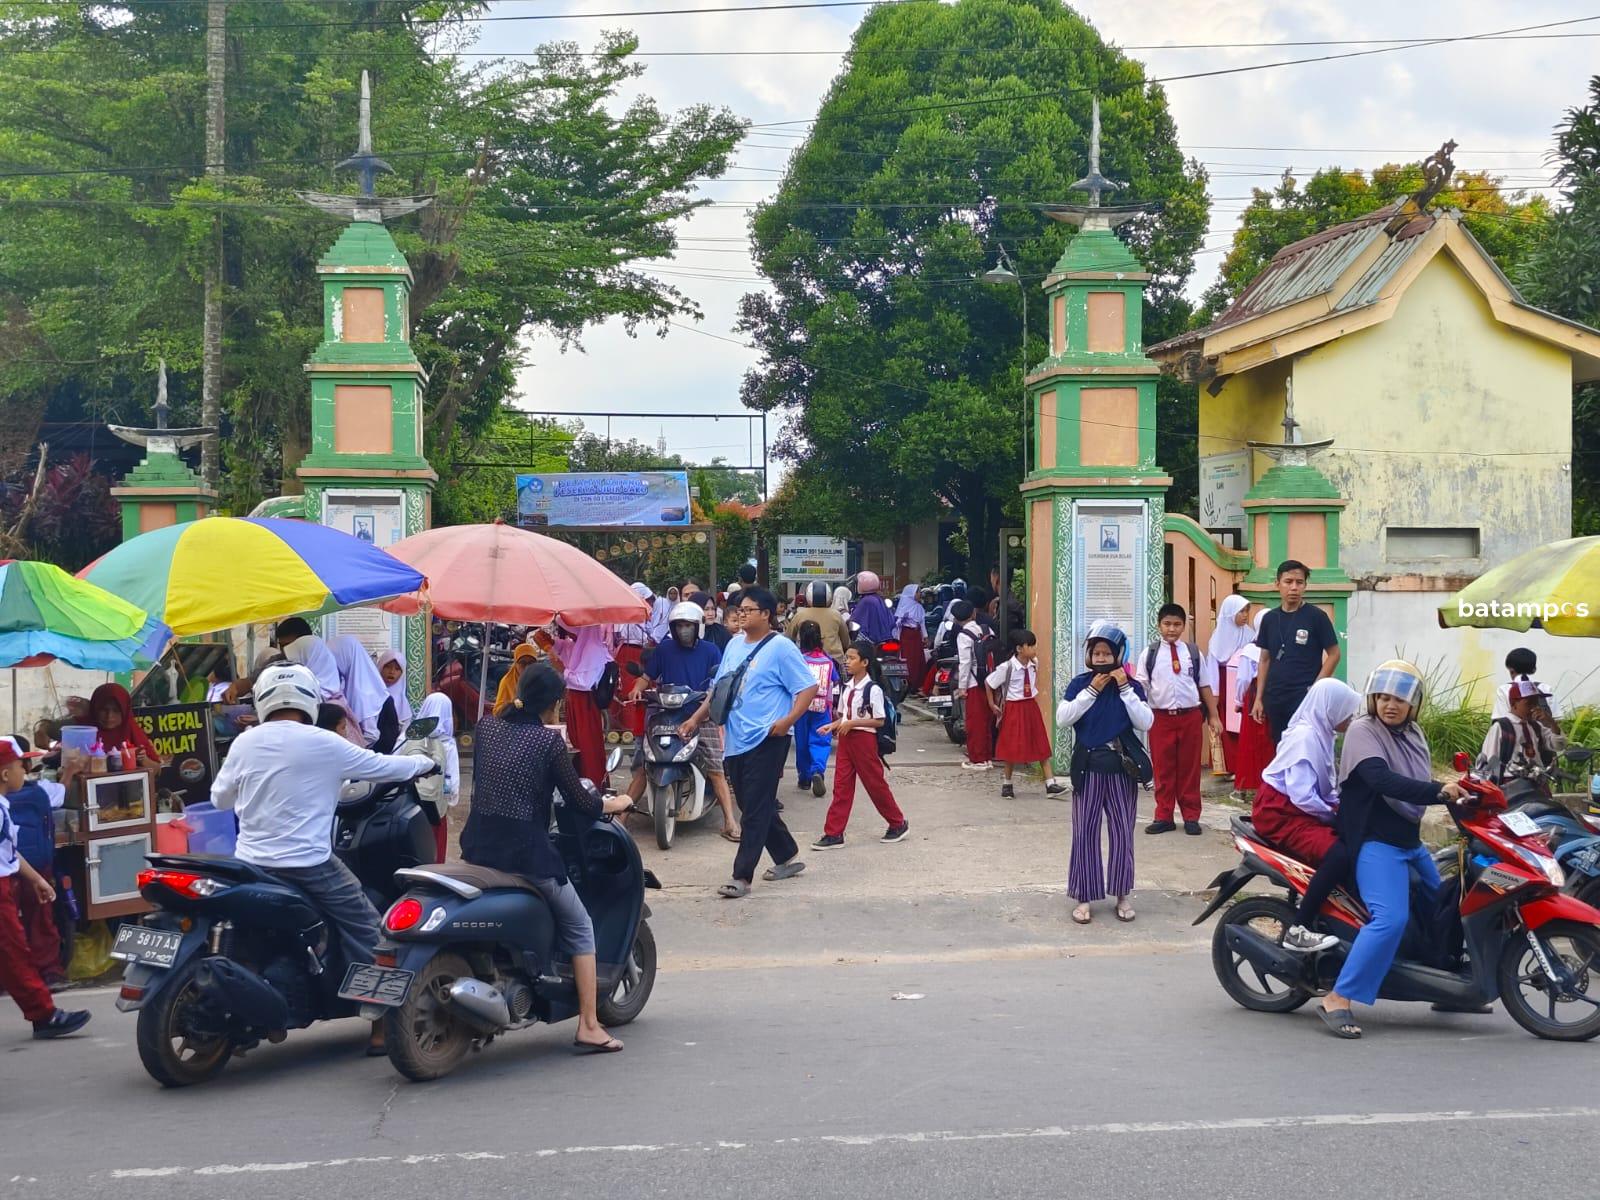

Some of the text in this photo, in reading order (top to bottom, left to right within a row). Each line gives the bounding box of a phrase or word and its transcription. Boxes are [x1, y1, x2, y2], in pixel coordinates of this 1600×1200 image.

[158, 711, 203, 732] KEPAL
[149, 734, 197, 755] OKLAT
[1490, 870, 1520, 883] HONDA
[119, 930, 133, 942] BP
